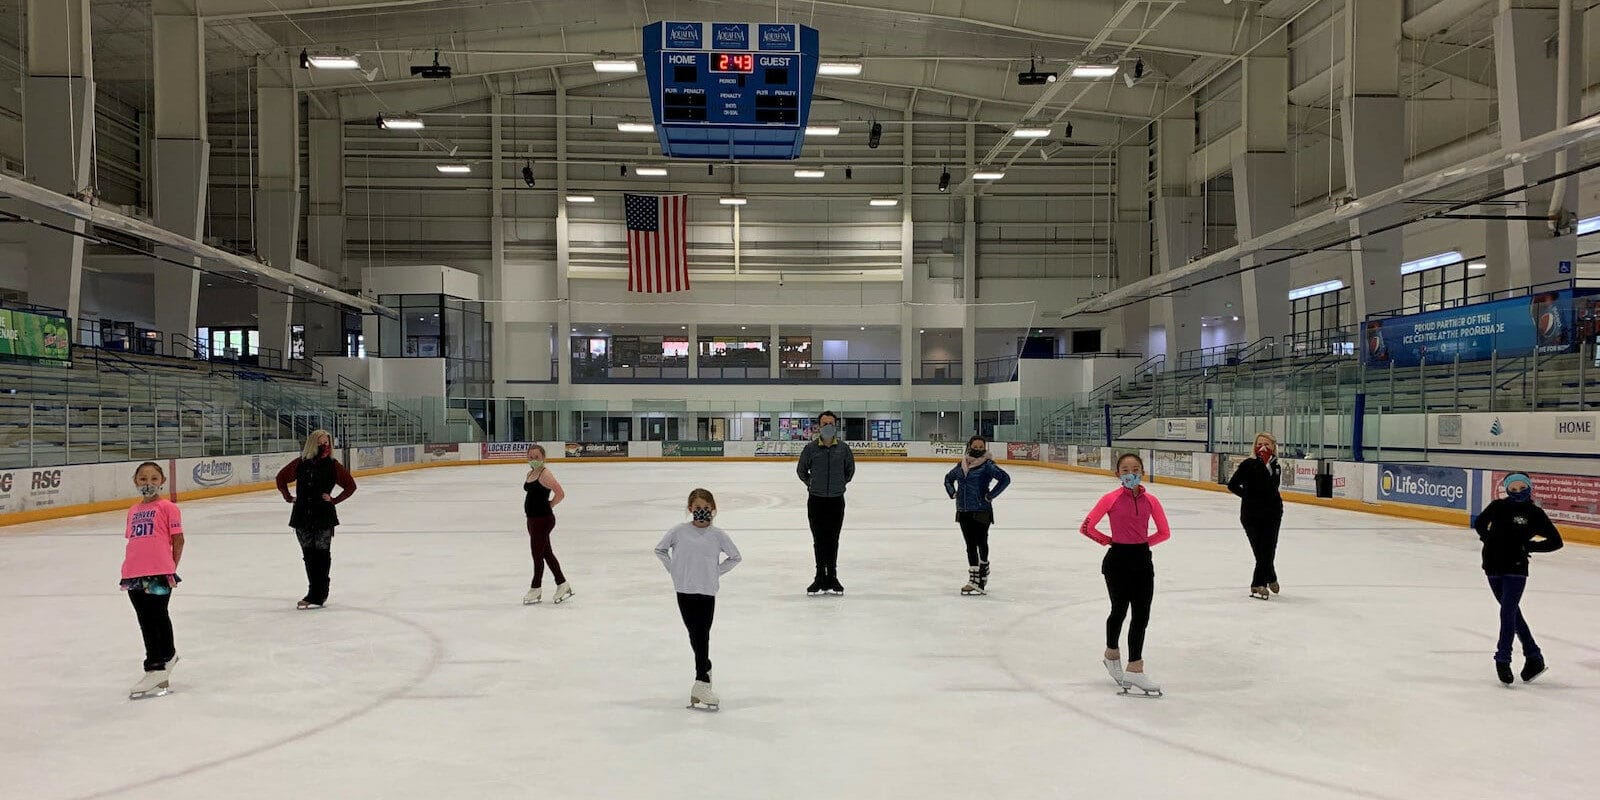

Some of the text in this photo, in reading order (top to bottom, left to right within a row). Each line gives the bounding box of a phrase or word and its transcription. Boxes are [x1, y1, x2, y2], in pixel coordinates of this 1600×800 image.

[670, 29, 698, 41] AQUAFINA
[716, 30, 745, 42] AQUAFINA
[763, 31, 791, 43] AQUAFINA
[669, 55, 696, 64] HOME
[720, 54, 752, 70] 2:43
[760, 57, 791, 66] GUEST
[1414, 313, 1491, 334] PROUD PARTNER OF THE
[1403, 335, 1413, 345] ICE
[1414, 331, 1438, 343] CENTRE
[1446, 329, 1458, 339] THE
[1460, 322, 1505, 338] PROMENADE
[1559, 421, 1592, 434] HOME
[488, 443, 512, 452] LOCKER
[31, 469, 61, 490] RSC
[130, 522, 154, 538] 2017
